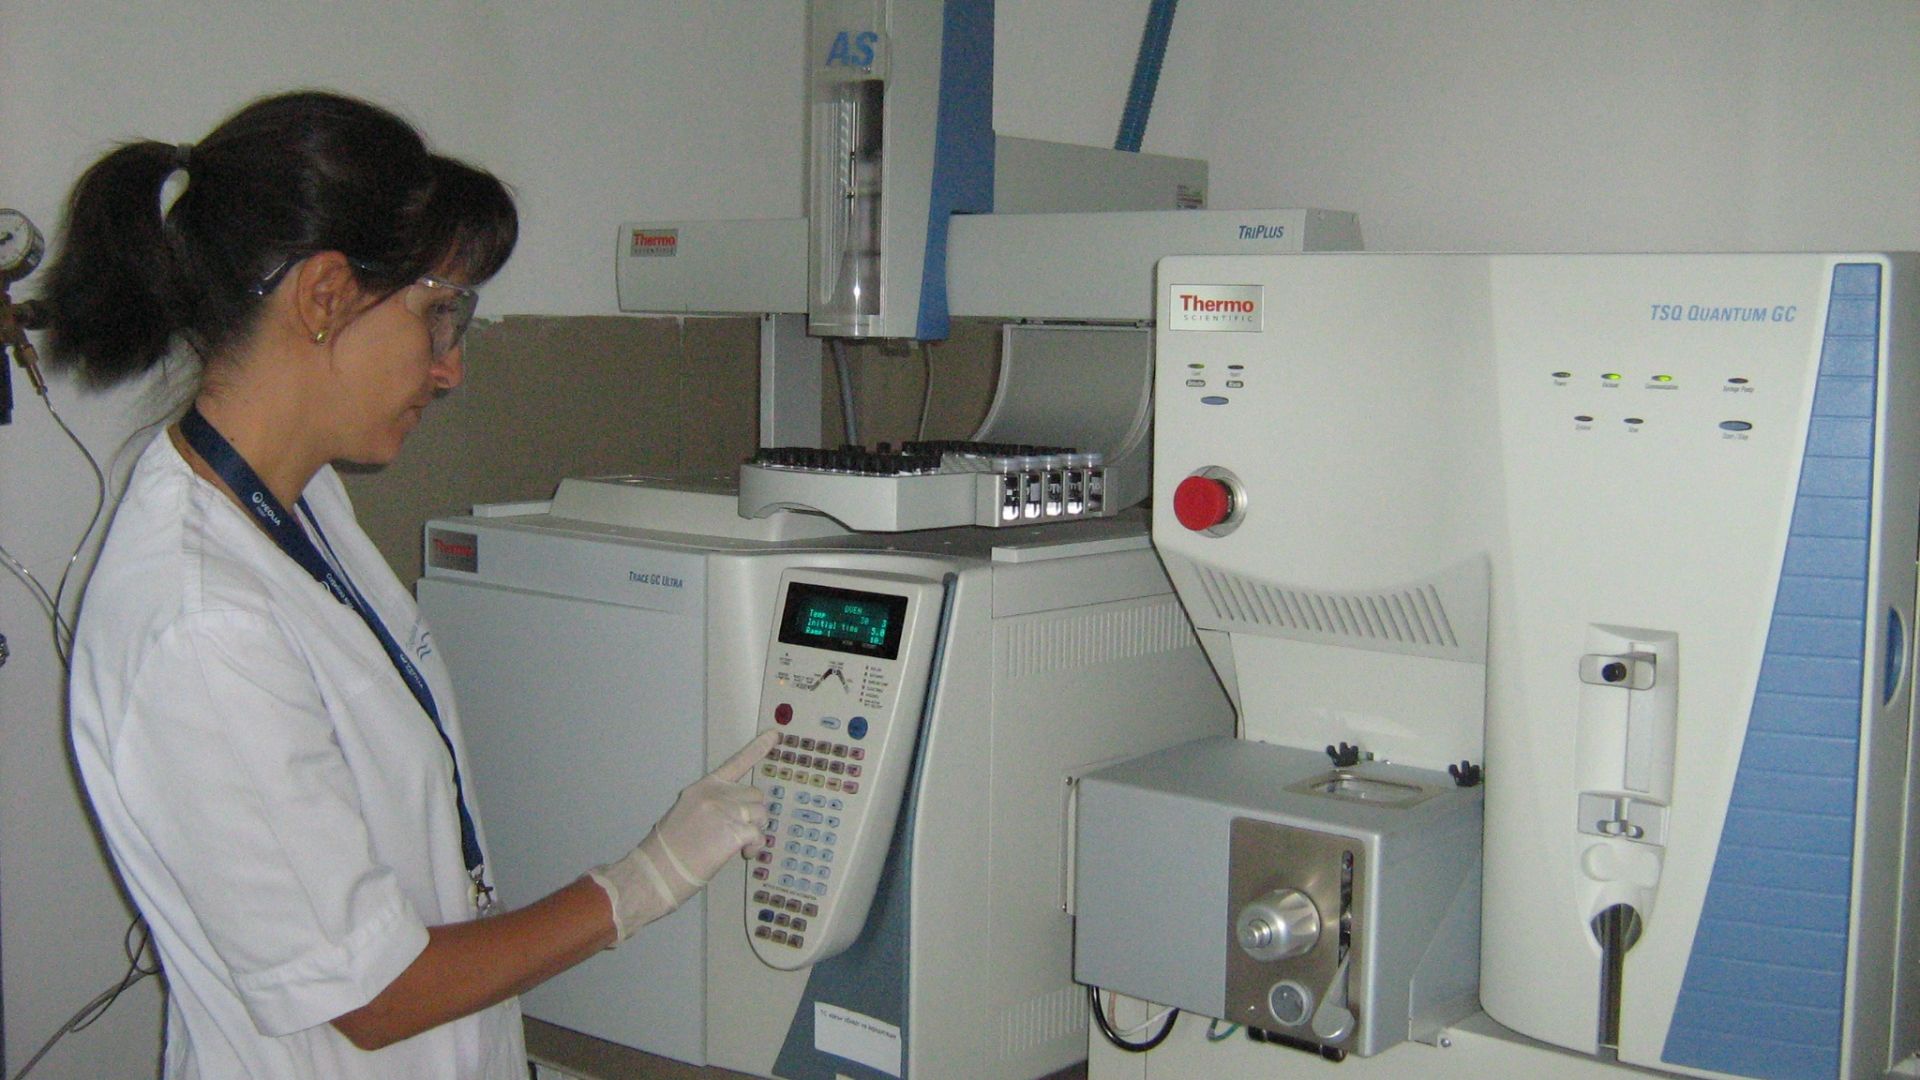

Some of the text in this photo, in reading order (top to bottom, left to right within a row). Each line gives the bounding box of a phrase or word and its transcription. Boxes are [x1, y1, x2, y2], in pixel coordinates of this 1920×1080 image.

[825, 31, 878, 66] AS
[632, 233, 676, 246] Thermo
[1180, 295, 1254, 313] Thermo
[1650, 304, 1797, 322] TSQ QUANTUM GC
[261, 501, 280, 526] VEOLIA
[650, 574, 661, 585] GC
[809, 608, 826, 618] Temp
[807, 617, 836, 630] Initial
[841, 623, 858, 633] time
